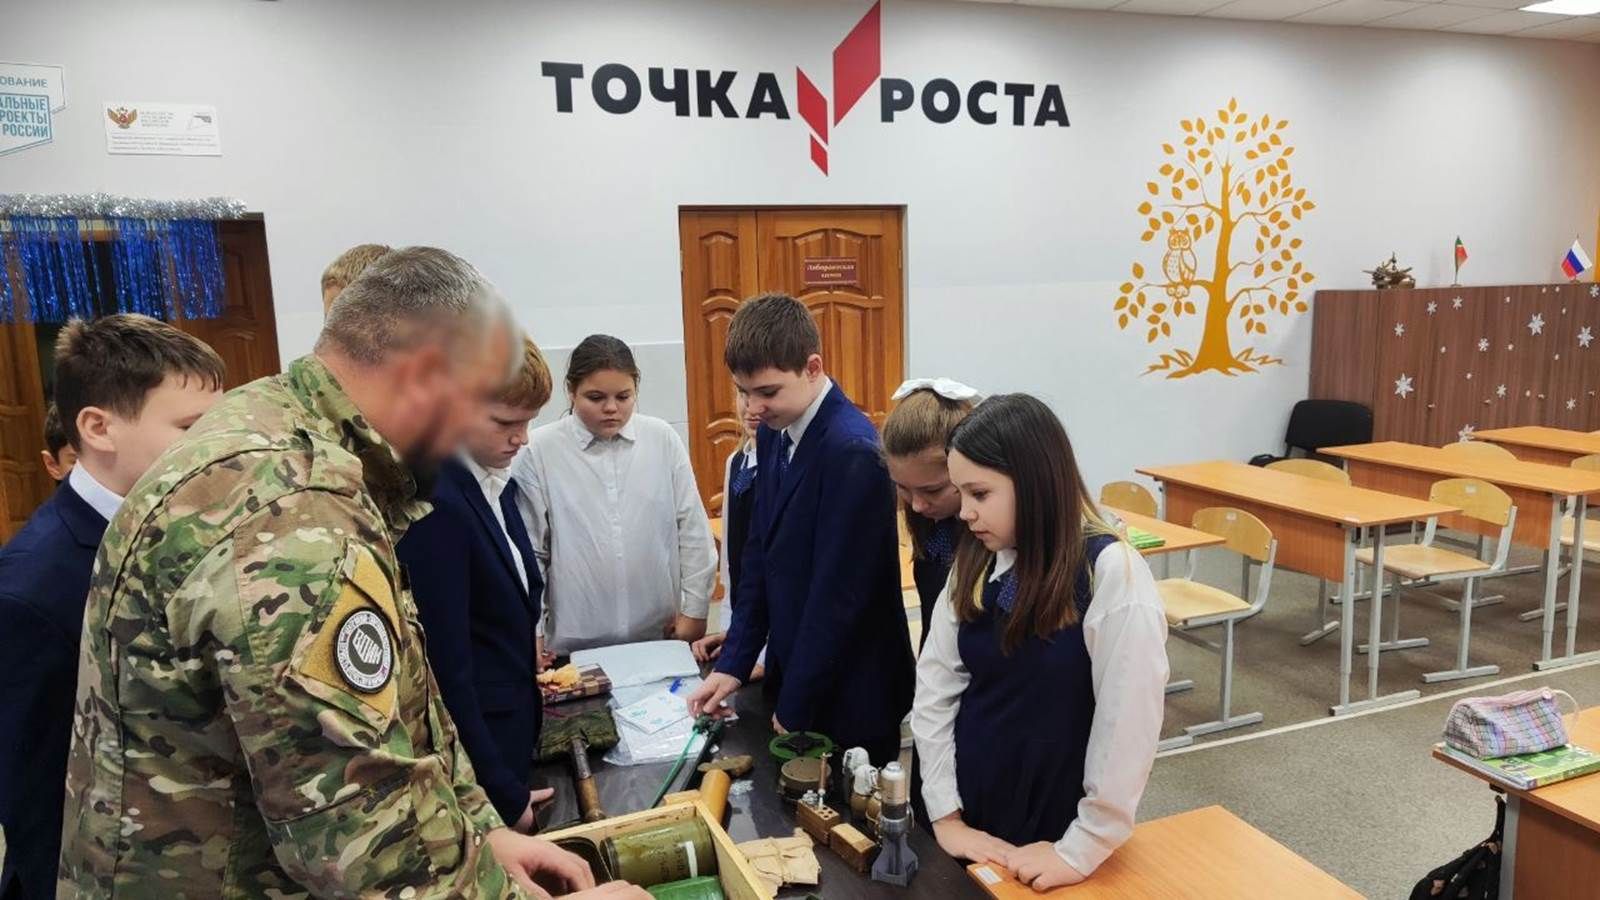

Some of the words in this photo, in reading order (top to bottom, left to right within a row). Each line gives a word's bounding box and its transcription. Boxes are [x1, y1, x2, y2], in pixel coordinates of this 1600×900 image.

[0, 75, 48, 88] ОВАНИЕ
[541, 61, 791, 119] ТОЧКА
[880, 77, 1070, 127] РОСТА
[2, 123, 48, 137] РОССИИ
